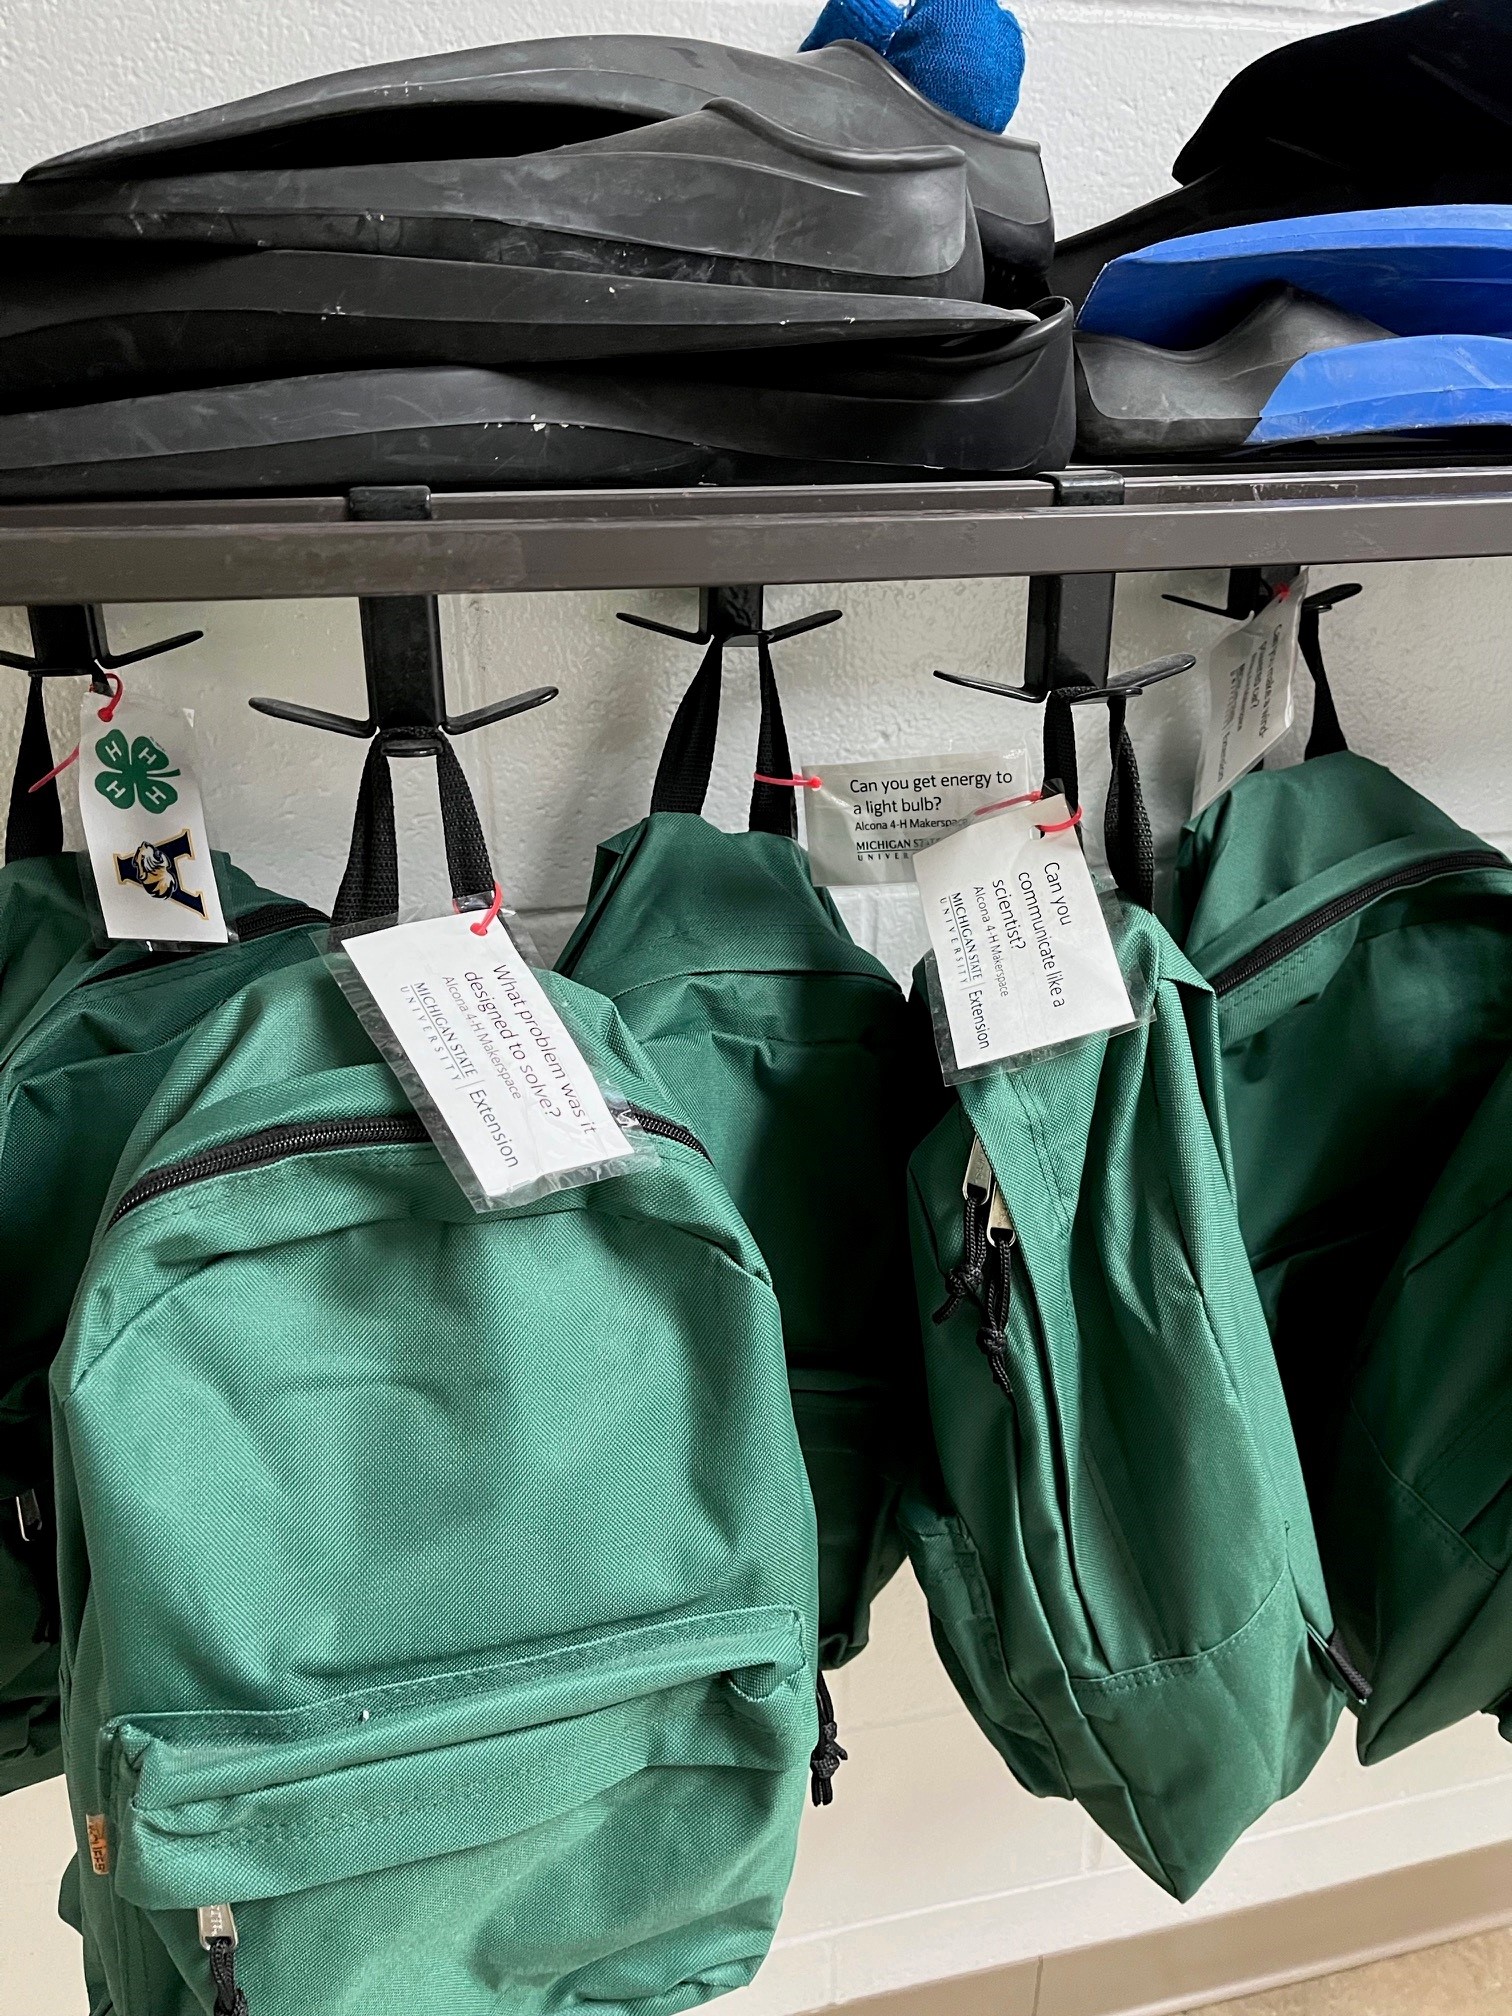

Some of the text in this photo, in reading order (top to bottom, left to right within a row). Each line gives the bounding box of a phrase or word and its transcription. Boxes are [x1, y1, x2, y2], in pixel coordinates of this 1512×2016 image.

[850, 771, 1013, 794] Can you get energy to
[853, 796, 942, 817] a light bulb?
[855, 821, 888, 831] Alcona
[890, 819, 907, 829] 4-H
[856, 839, 911, 851] MICHIGAN
[951, 892, 982, 981] MICHIGAN STATE
[992, 879, 1026, 950] scientist?
[1044, 862, 1072, 925] Can you
[940, 897, 968, 984] UNIVERSITY
[973, 886, 1009, 997] Alcona 4-H Makerspace
[1018, 872, 1065, 1008] communicate like a
[400, 985, 462, 1083] UNIVERSITY
[414, 982, 478, 1078] MICHIGAN STATE
[442, 976, 521, 1100] Alcona 4-H Makerspace
[464, 971, 561, 1118] designed to solve?
[493, 964, 597, 1135] What problem was it
[968, 989, 991, 1049] Extension
[468, 1088, 519, 1168] Extension
